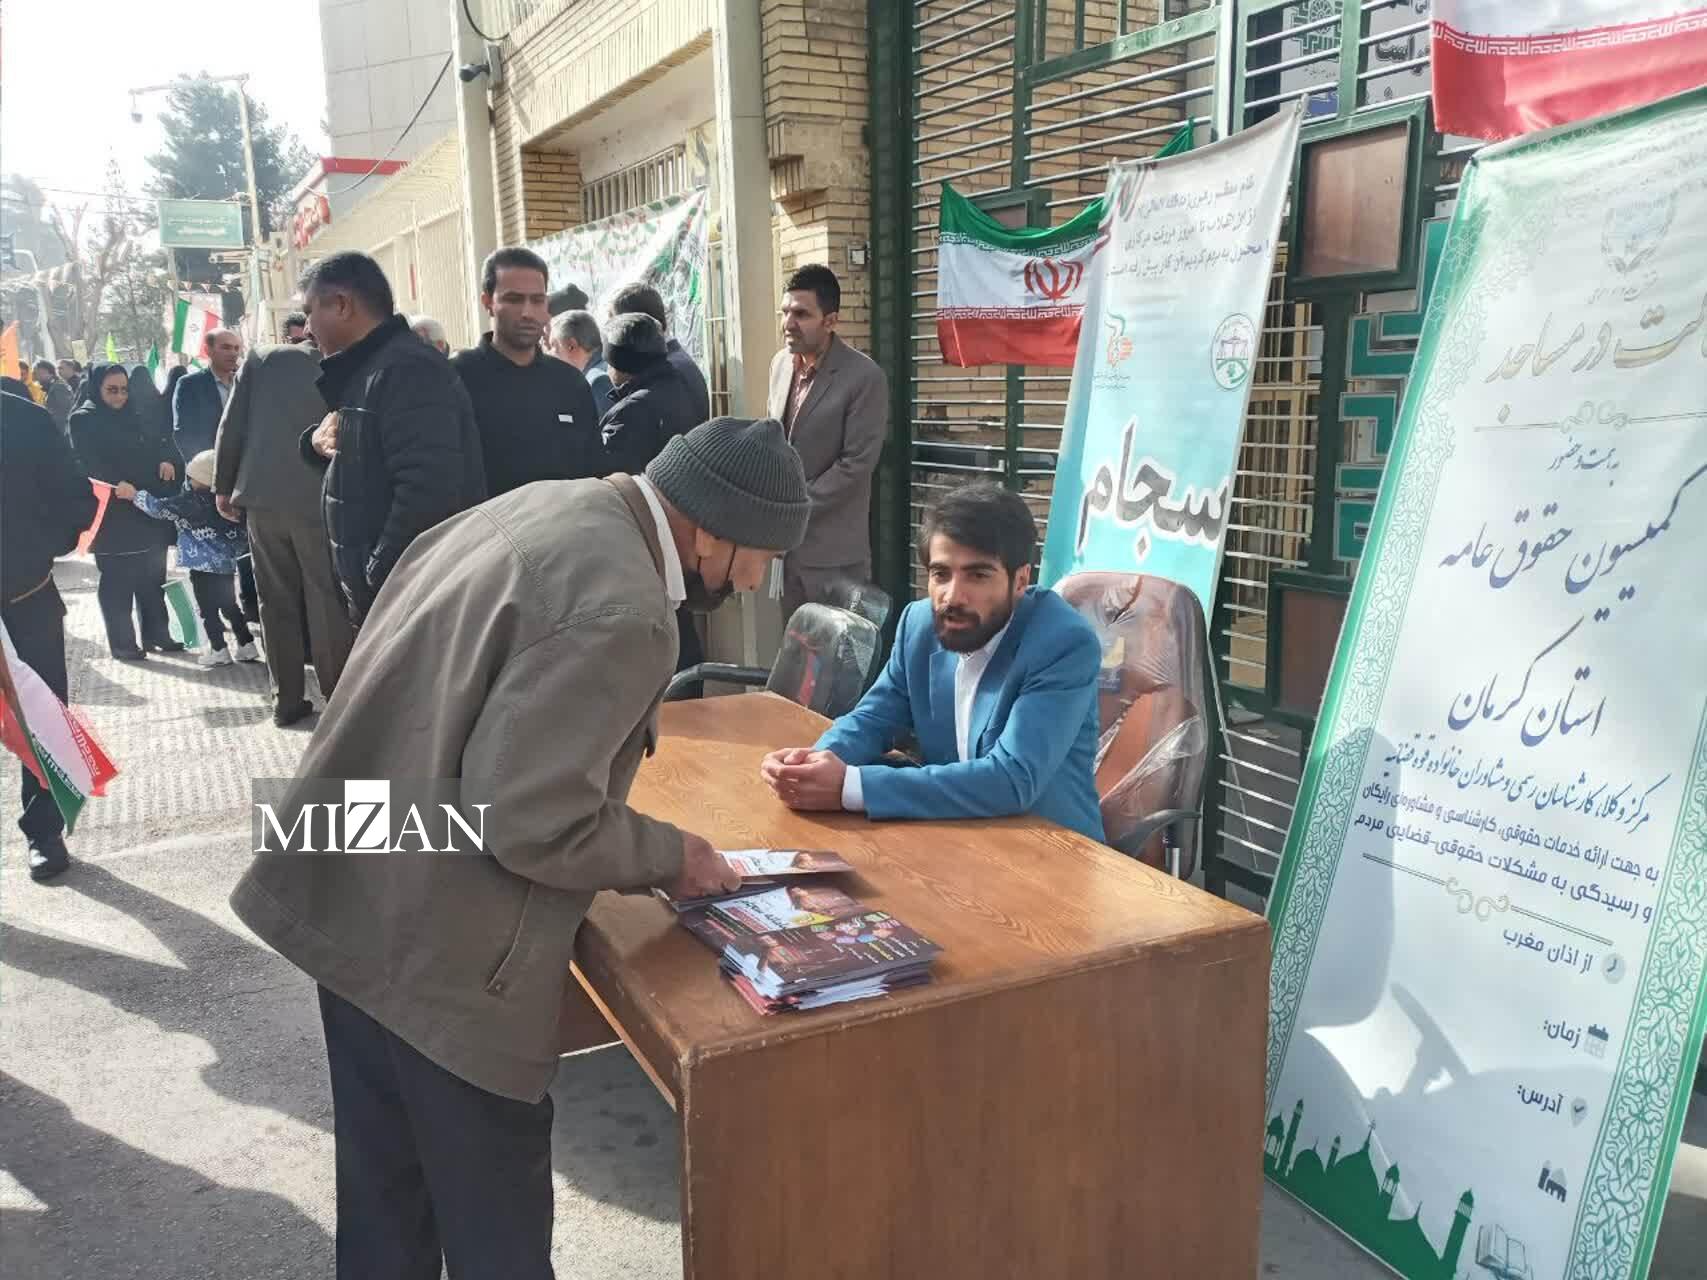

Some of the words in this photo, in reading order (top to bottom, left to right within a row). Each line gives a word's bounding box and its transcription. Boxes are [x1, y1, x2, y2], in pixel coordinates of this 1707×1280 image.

[1485, 311, 1585, 425] مساجد
[1075, 418, 1229, 556] سجام
[1437, 521, 1494, 569] عامه
[1489, 501, 1574, 589] حقوق
[1564, 462, 1707, 622] کمیسیون
[1447, 615, 1585, 732] کرمان
[1520, 665, 1607, 748] استان
[1426, 743, 1463, 779] خانواده
[1457, 756, 1505, 790] مشاوران
[1362, 782, 1391, 806] رایگان
[1507, 775, 1538, 803] رسمی
[1534, 771, 1609, 812] کارشناسان
[1435, 805, 1443, 821] و
[1624, 773, 1673, 835] مرکز
[1354, 813, 1385, 832] مردم
[1442, 808, 1497, 833] کارشناسی
[1543, 835, 1581, 858] خدمات
[1584, 845, 1610, 871] ارائه
[1487, 855, 1548, 884] مشکلات
[1610, 856, 1641, 881] جهت
[1645, 866, 1660, 888] به
[1551, 874, 1568, 896] به
[1570, 883, 1640, 919] رسیدگی
[1642, 905, 1653, 924] و
[1502, 926, 1544, 953] مغرب
[1547, 945, 1578, 967] اذان
[1580, 953, 1593, 974] از
[1543, 1019, 1581, 1049] زمان:
[1516, 1084, 1564, 1115] آدرس:
